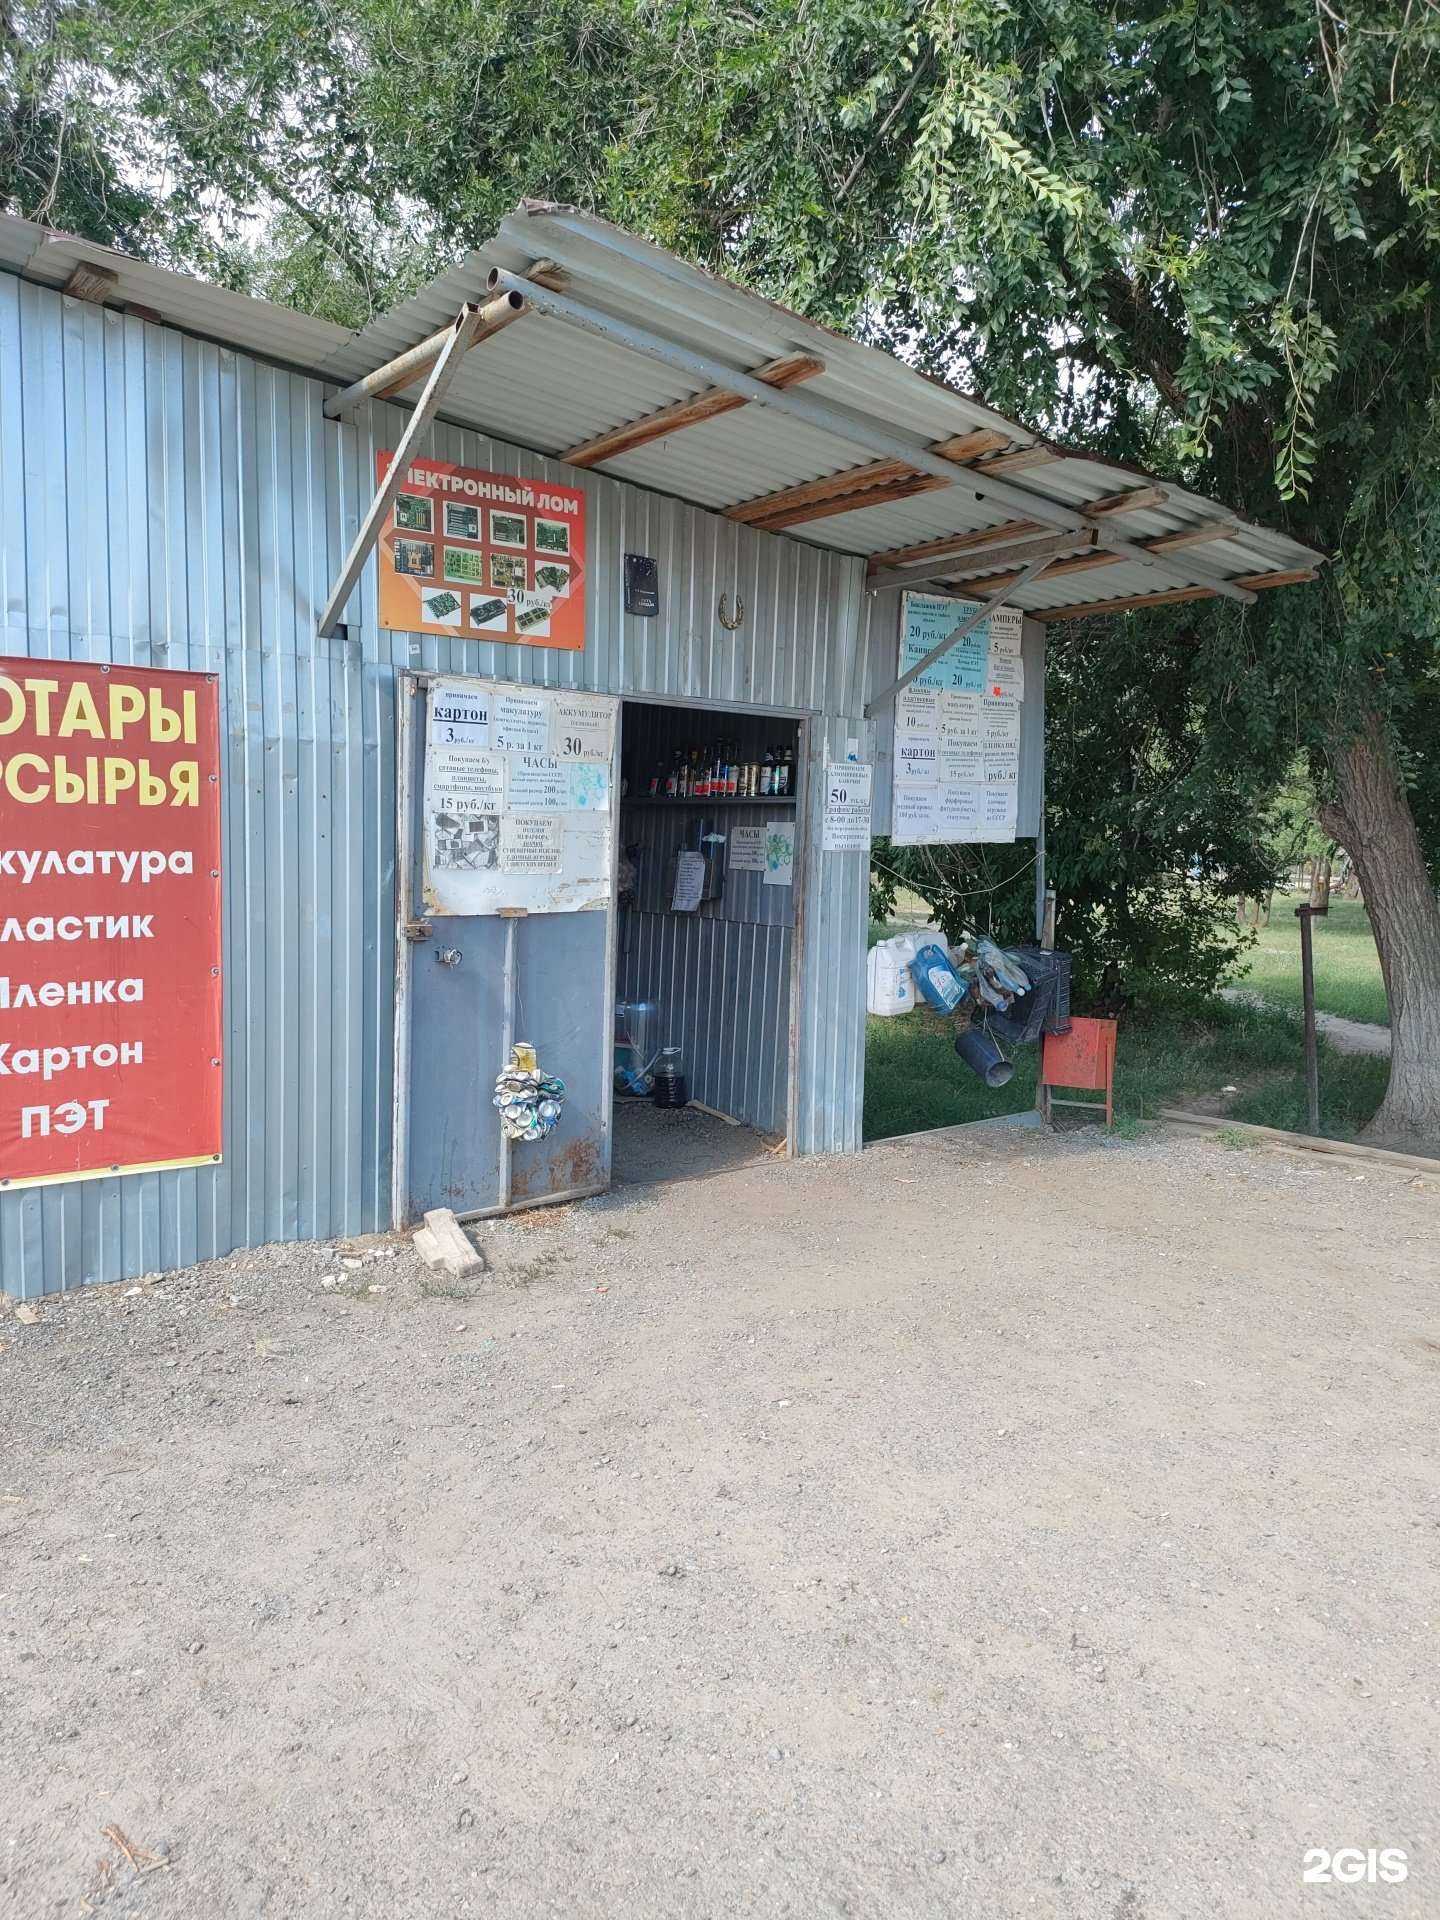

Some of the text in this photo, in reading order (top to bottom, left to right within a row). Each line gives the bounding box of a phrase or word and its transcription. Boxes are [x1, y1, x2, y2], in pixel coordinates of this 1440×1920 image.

[408, 468, 578, 515] ЕКТРОННЫЙ ЛОМ
[508, 588, 525, 603] 30
[910, 625, 921, 638] 20
[962, 636, 972, 647] 20
[994, 641, 1000, 653] 5
[952, 674, 963, 685] 20
[434, 706, 488, 721] картон
[907, 716, 916, 727] 10
[941, 723, 947, 734] 5
[446, 727, 454, 743] 3
[497, 736, 504, 748] 5
[533, 744, 544, 752] кг
[563, 736, 582, 755] 30
[901, 747, 936, 758] картон
[523, 757, 558, 769] ЧАСЫ
[906, 762, 912, 775] 3
[0, 752, 200, 807] СЫРЬЯ
[543, 785, 556, 794] 200
[831, 788, 847, 803] 50
[441, 797, 496, 812] 15 руб./кг
[0, 848, 193, 884] кулатура
[0, 914, 154, 942] ластик
[21, 1099, 110, 1138] ПЭТ
